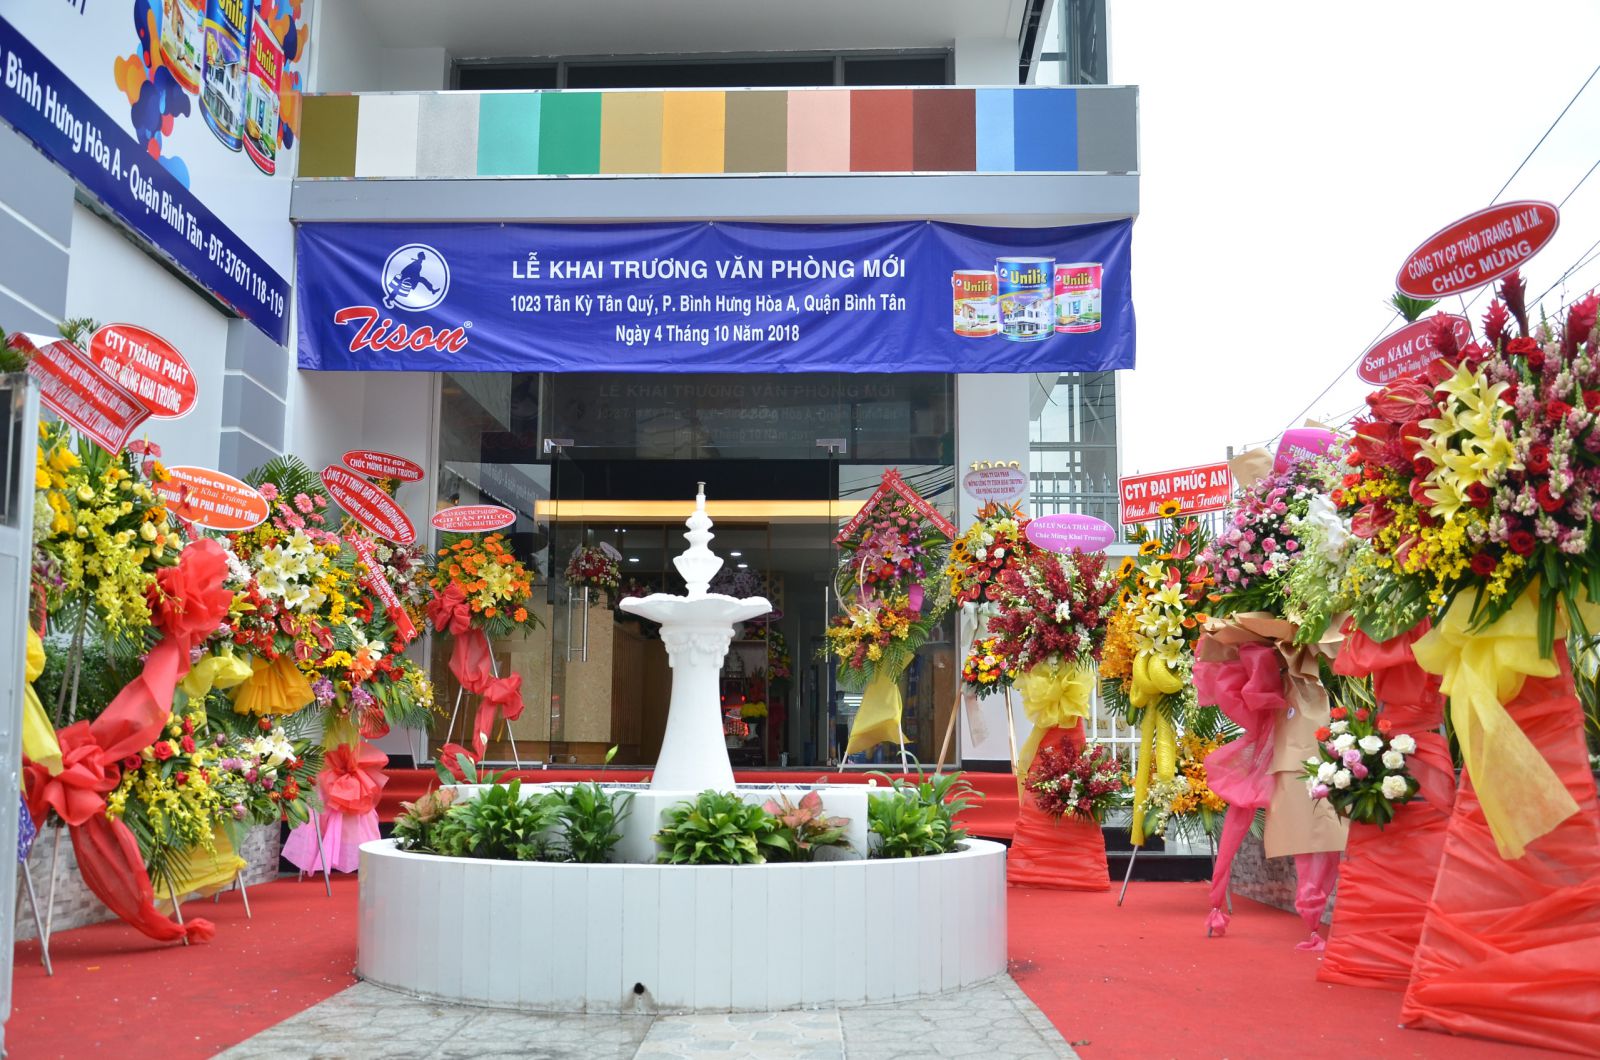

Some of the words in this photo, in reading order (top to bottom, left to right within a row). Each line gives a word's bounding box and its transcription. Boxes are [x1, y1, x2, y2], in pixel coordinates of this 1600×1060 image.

[5, 50, 42, 111] Bình
[44, 85, 83, 153] Hưng
[85, 121, 110, 173] Hòa
[111, 148, 122, 181] A
[129, 164, 160, 215] Quận
[160, 190, 186, 236] Bình
[186, 211, 203, 251] Tân
[208, 233, 225, 269] ĐT:
[224, 248, 251, 291] 37671
[512, 251, 540, 280] LỄ
[550, 259, 605, 279] KHAI
[610, 257, 709, 280] TRƯƠNG
[715, 255, 766, 280] VĂN
[771, 256, 856, 280] PHÒNG
[863, 254, 906, 279] MỚI
[1408, 258, 1433, 280] CÔNG
[1432, 251, 1445, 270] TY
[1445, 246, 1457, 264] CP
[1459, 232, 1480, 258] THỜI
[1481, 223, 1512, 248] TRANG
[1432, 263, 1477, 293] CHÚC
[1480, 240, 1532, 274] MỪNG
[510, 295, 542, 313] 1023
[545, 294, 572, 313] Tân
[597, 294, 625, 313] Tân
[628, 293, 659, 317] Quý,
[663, 295, 676, 312] P.
[680, 293, 712, 313] Bình
[715, 295, 752, 317] Hưng
[755, 293, 783, 313] Hòa
[785, 295, 800, 315] A,
[804, 293, 840, 317] Quận
[844, 293, 878, 312] Bình
[879, 292, 906, 312] Tân
[334, 305, 469, 354] Tison
[615, 325, 651, 346] Ngày
[654, 326, 662, 341] 4
[666, 324, 709, 346] Tháng
[713, 325, 730, 342] 10
[733, 324, 764, 342] Năm
[768, 325, 800, 341] 2018
[105, 329, 126, 353] CTY
[162, 361, 188, 386] PHÁT
[1388, 340, 1412, 363] NAM
[1125, 481, 1147, 500] CTY
[1150, 478, 1170, 499] ĐẠI
[1173, 470, 1206, 492] PHÚC
[1210, 469, 1227, 487] AN
